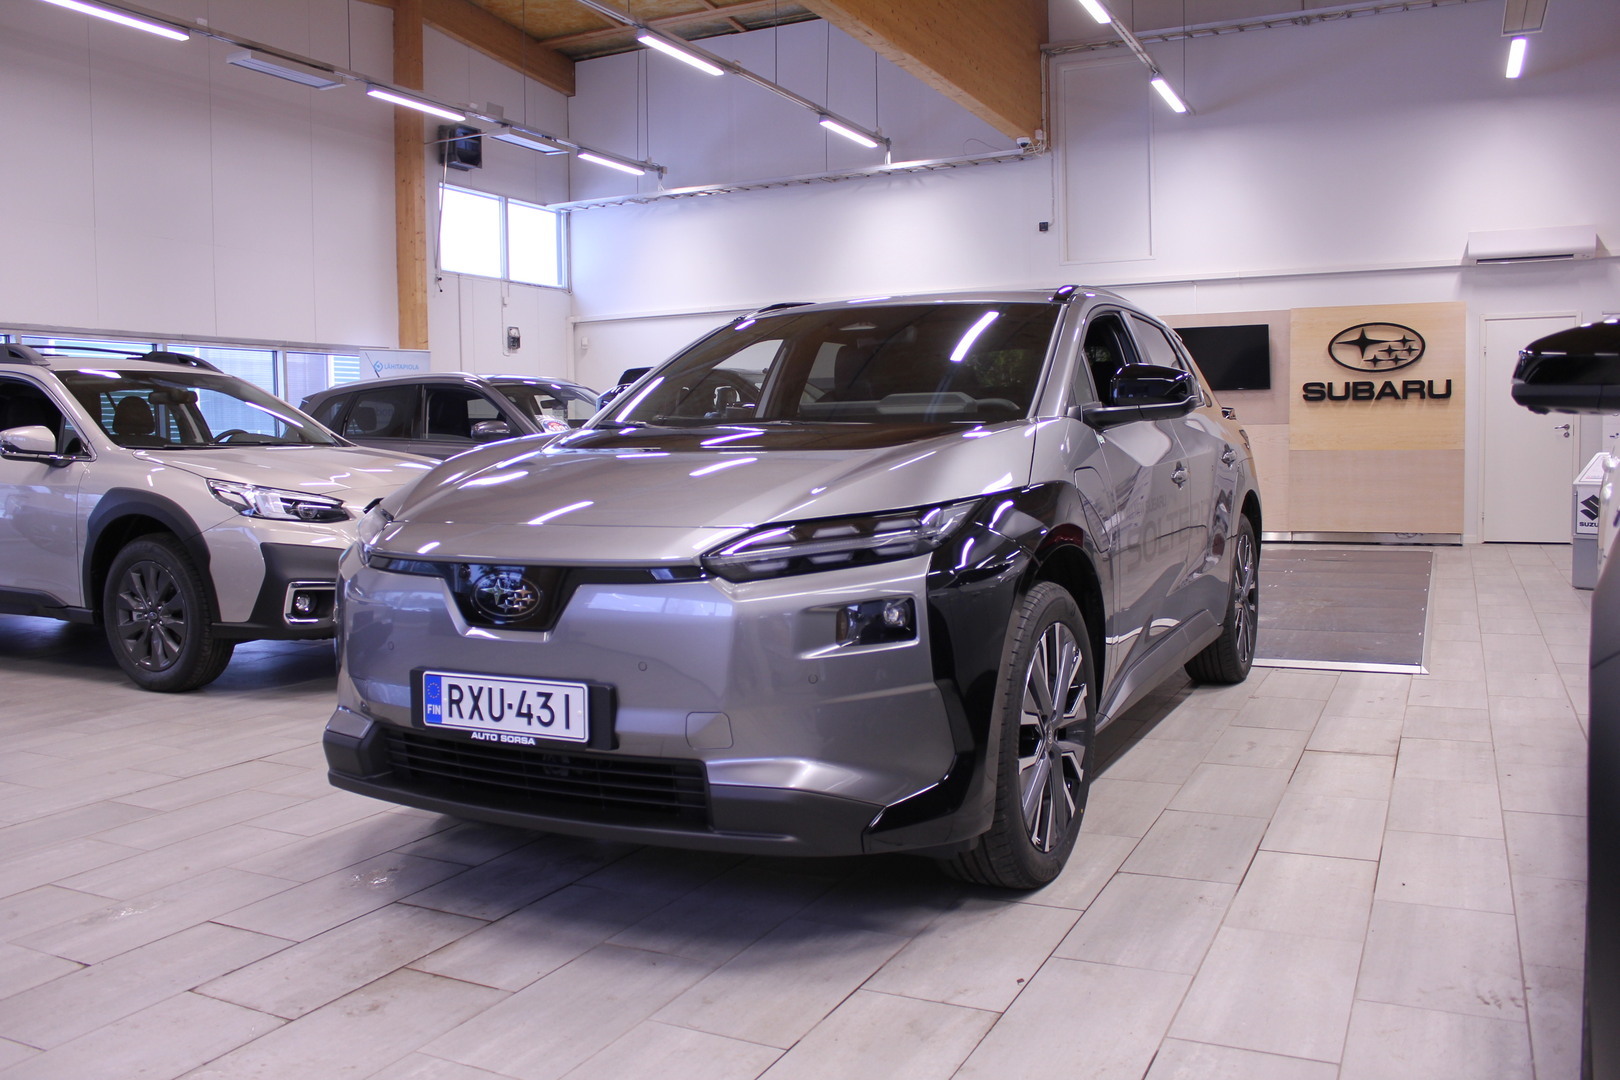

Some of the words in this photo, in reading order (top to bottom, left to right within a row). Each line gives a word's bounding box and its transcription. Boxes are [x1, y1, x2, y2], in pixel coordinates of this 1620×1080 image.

[1302, 379, 1452, 402] SUBARU
[427, 704, 441, 716] FIN
[447, 683, 571, 730] RXU-431
[470, 731, 498, 742] AUTO
[500, 734, 536, 746] SORSA
